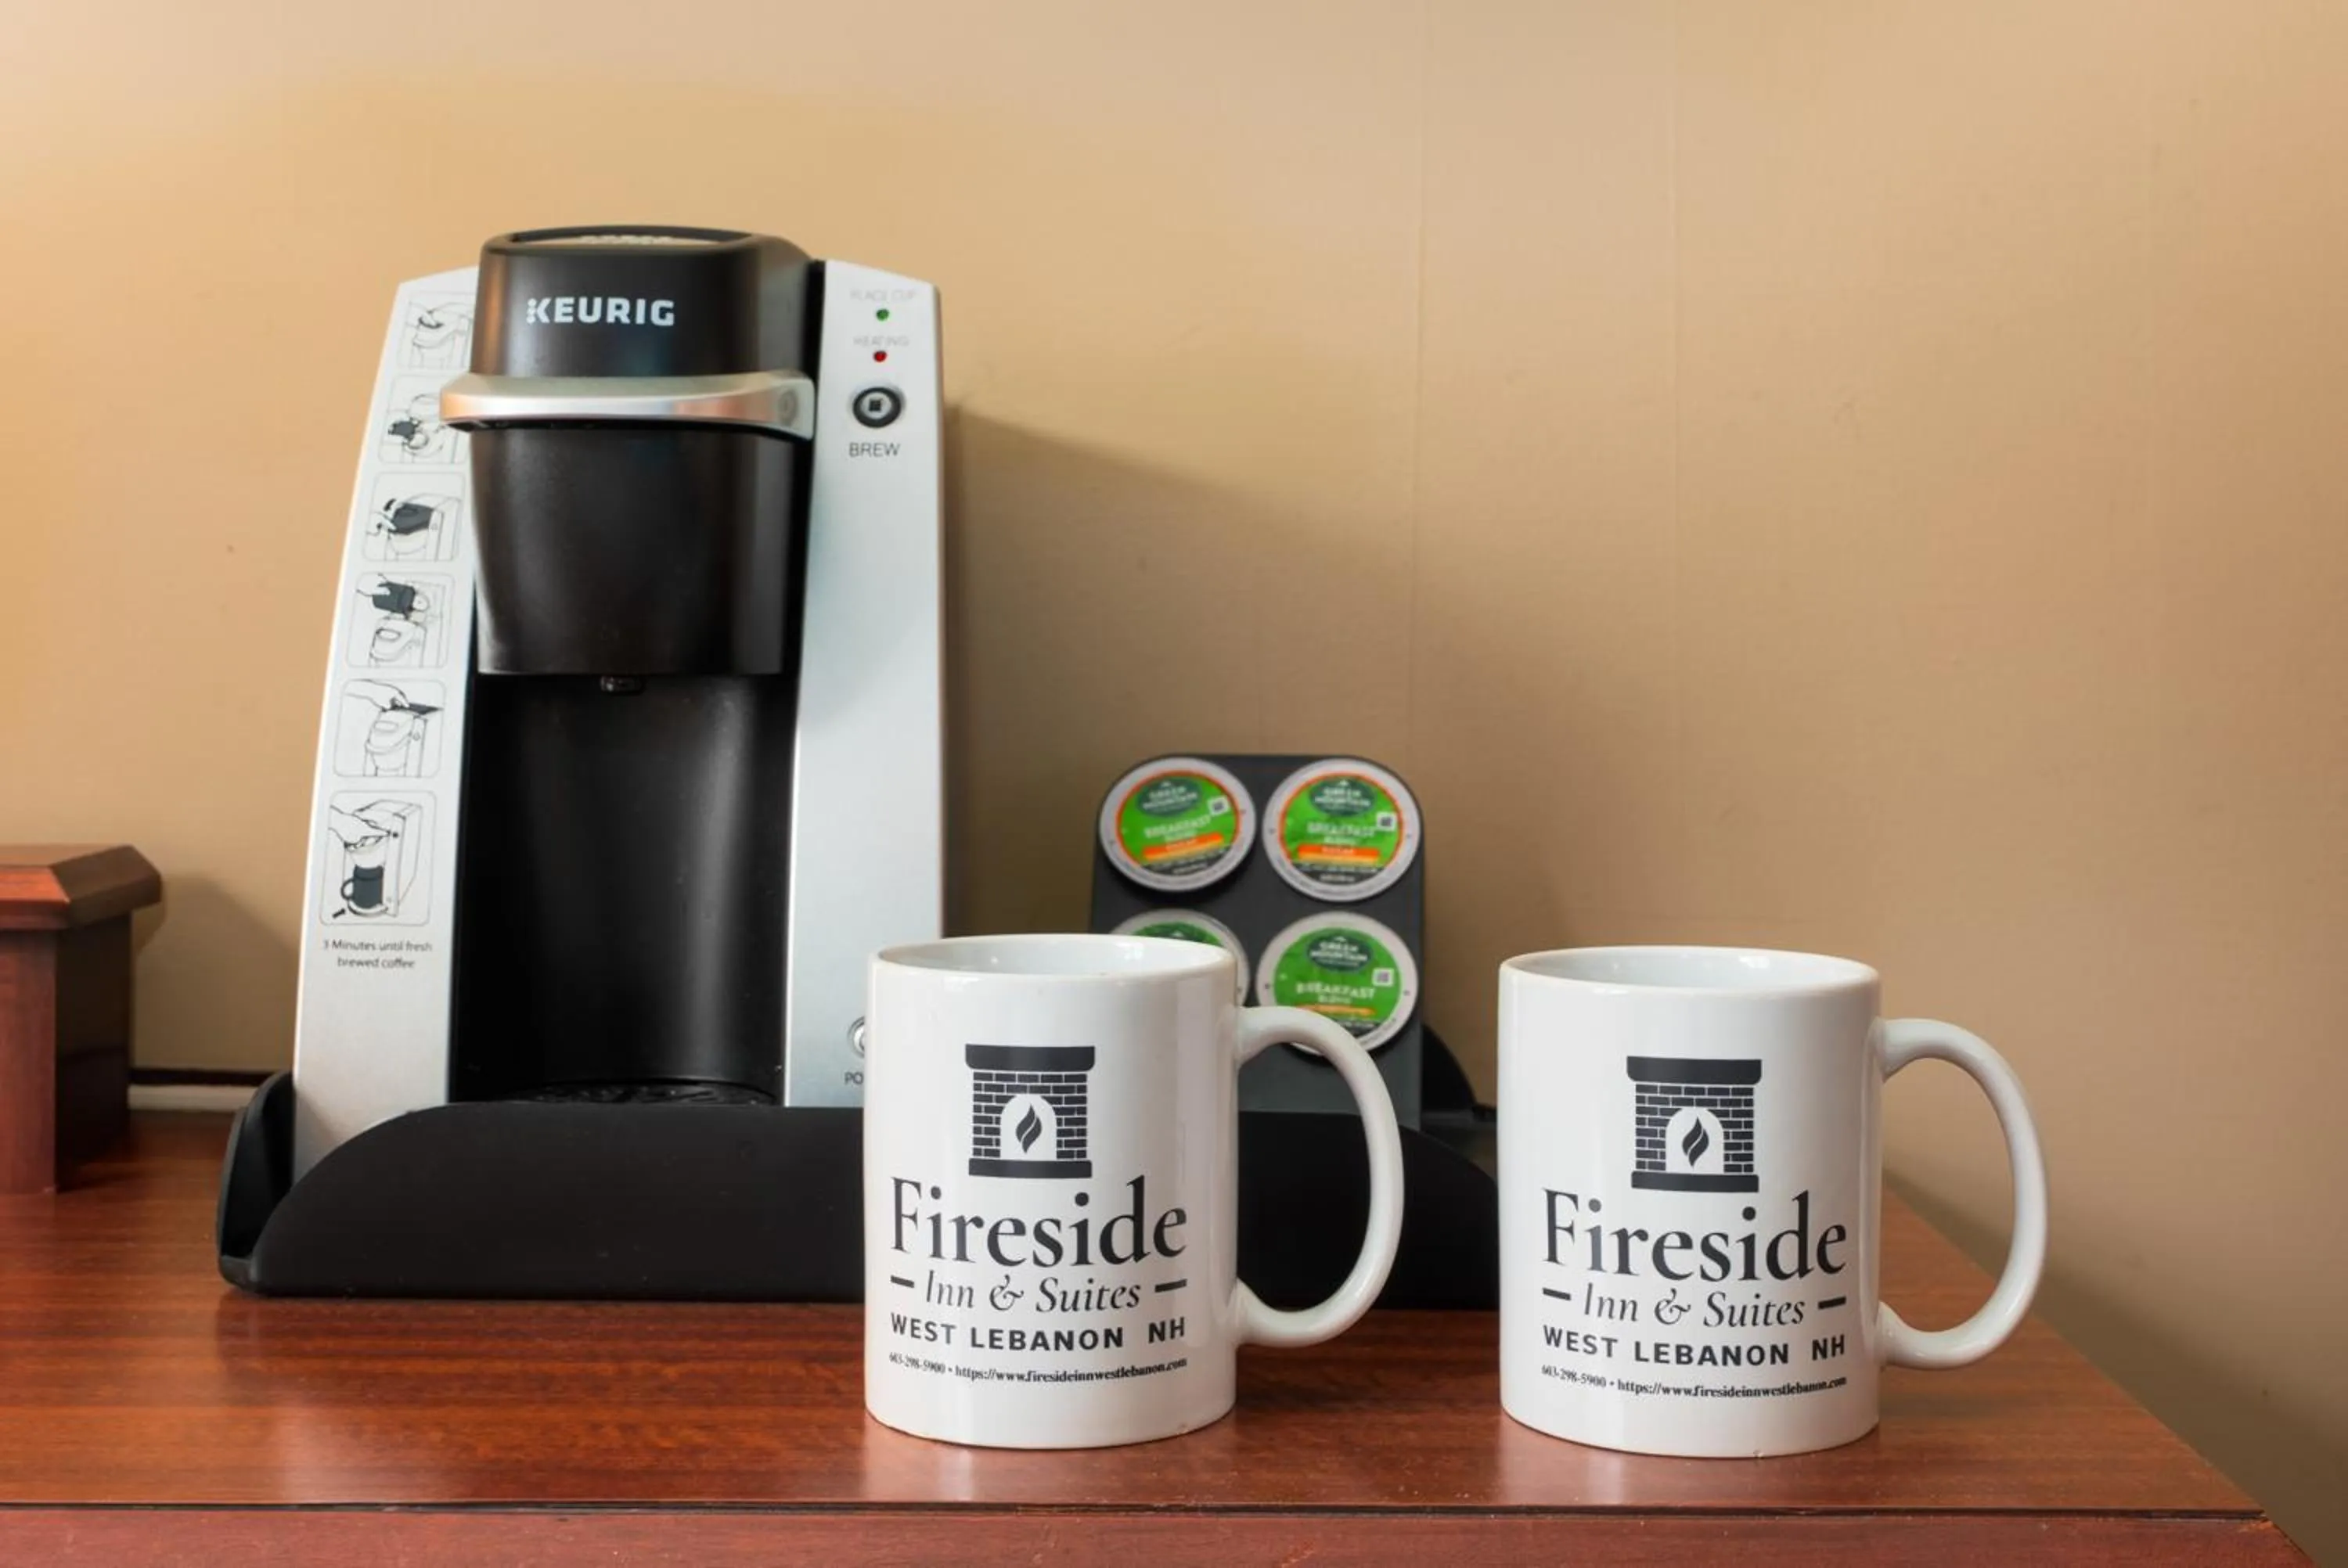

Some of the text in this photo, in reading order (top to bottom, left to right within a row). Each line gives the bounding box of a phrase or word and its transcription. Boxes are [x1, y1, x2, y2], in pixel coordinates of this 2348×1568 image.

[526, 296, 675, 326] KEURIG
[853, 335, 910, 347] HEATING
[848, 442, 901, 457] BREW
[332, 938, 376, 951] Minutes
[379, 940, 403, 951] until
[405, 940, 432, 951] fresh
[337, 956, 415, 969] brewed coffee
[1295, 982, 1376, 1000] BREAKFAST
[891, 1175, 1187, 1268] Fireside
[1542, 1188, 1846, 1282] Fireside
[926, 1270, 1141, 1313] Inn & Suites
[1584, 1283, 1806, 1327] Inn & Suites
[891, 1312, 1185, 1351] WEST LEBANON NH
[1543, 1325, 1845, 1367] WEST LEBANON NH
[889, 1351, 1187, 1383] 603-298-5900 https://www.firesideinnwestlebanon.com
[1541, 1364, 1847, 1397] 603-298-5900 https://www.firesideinnwestlebanon.com
